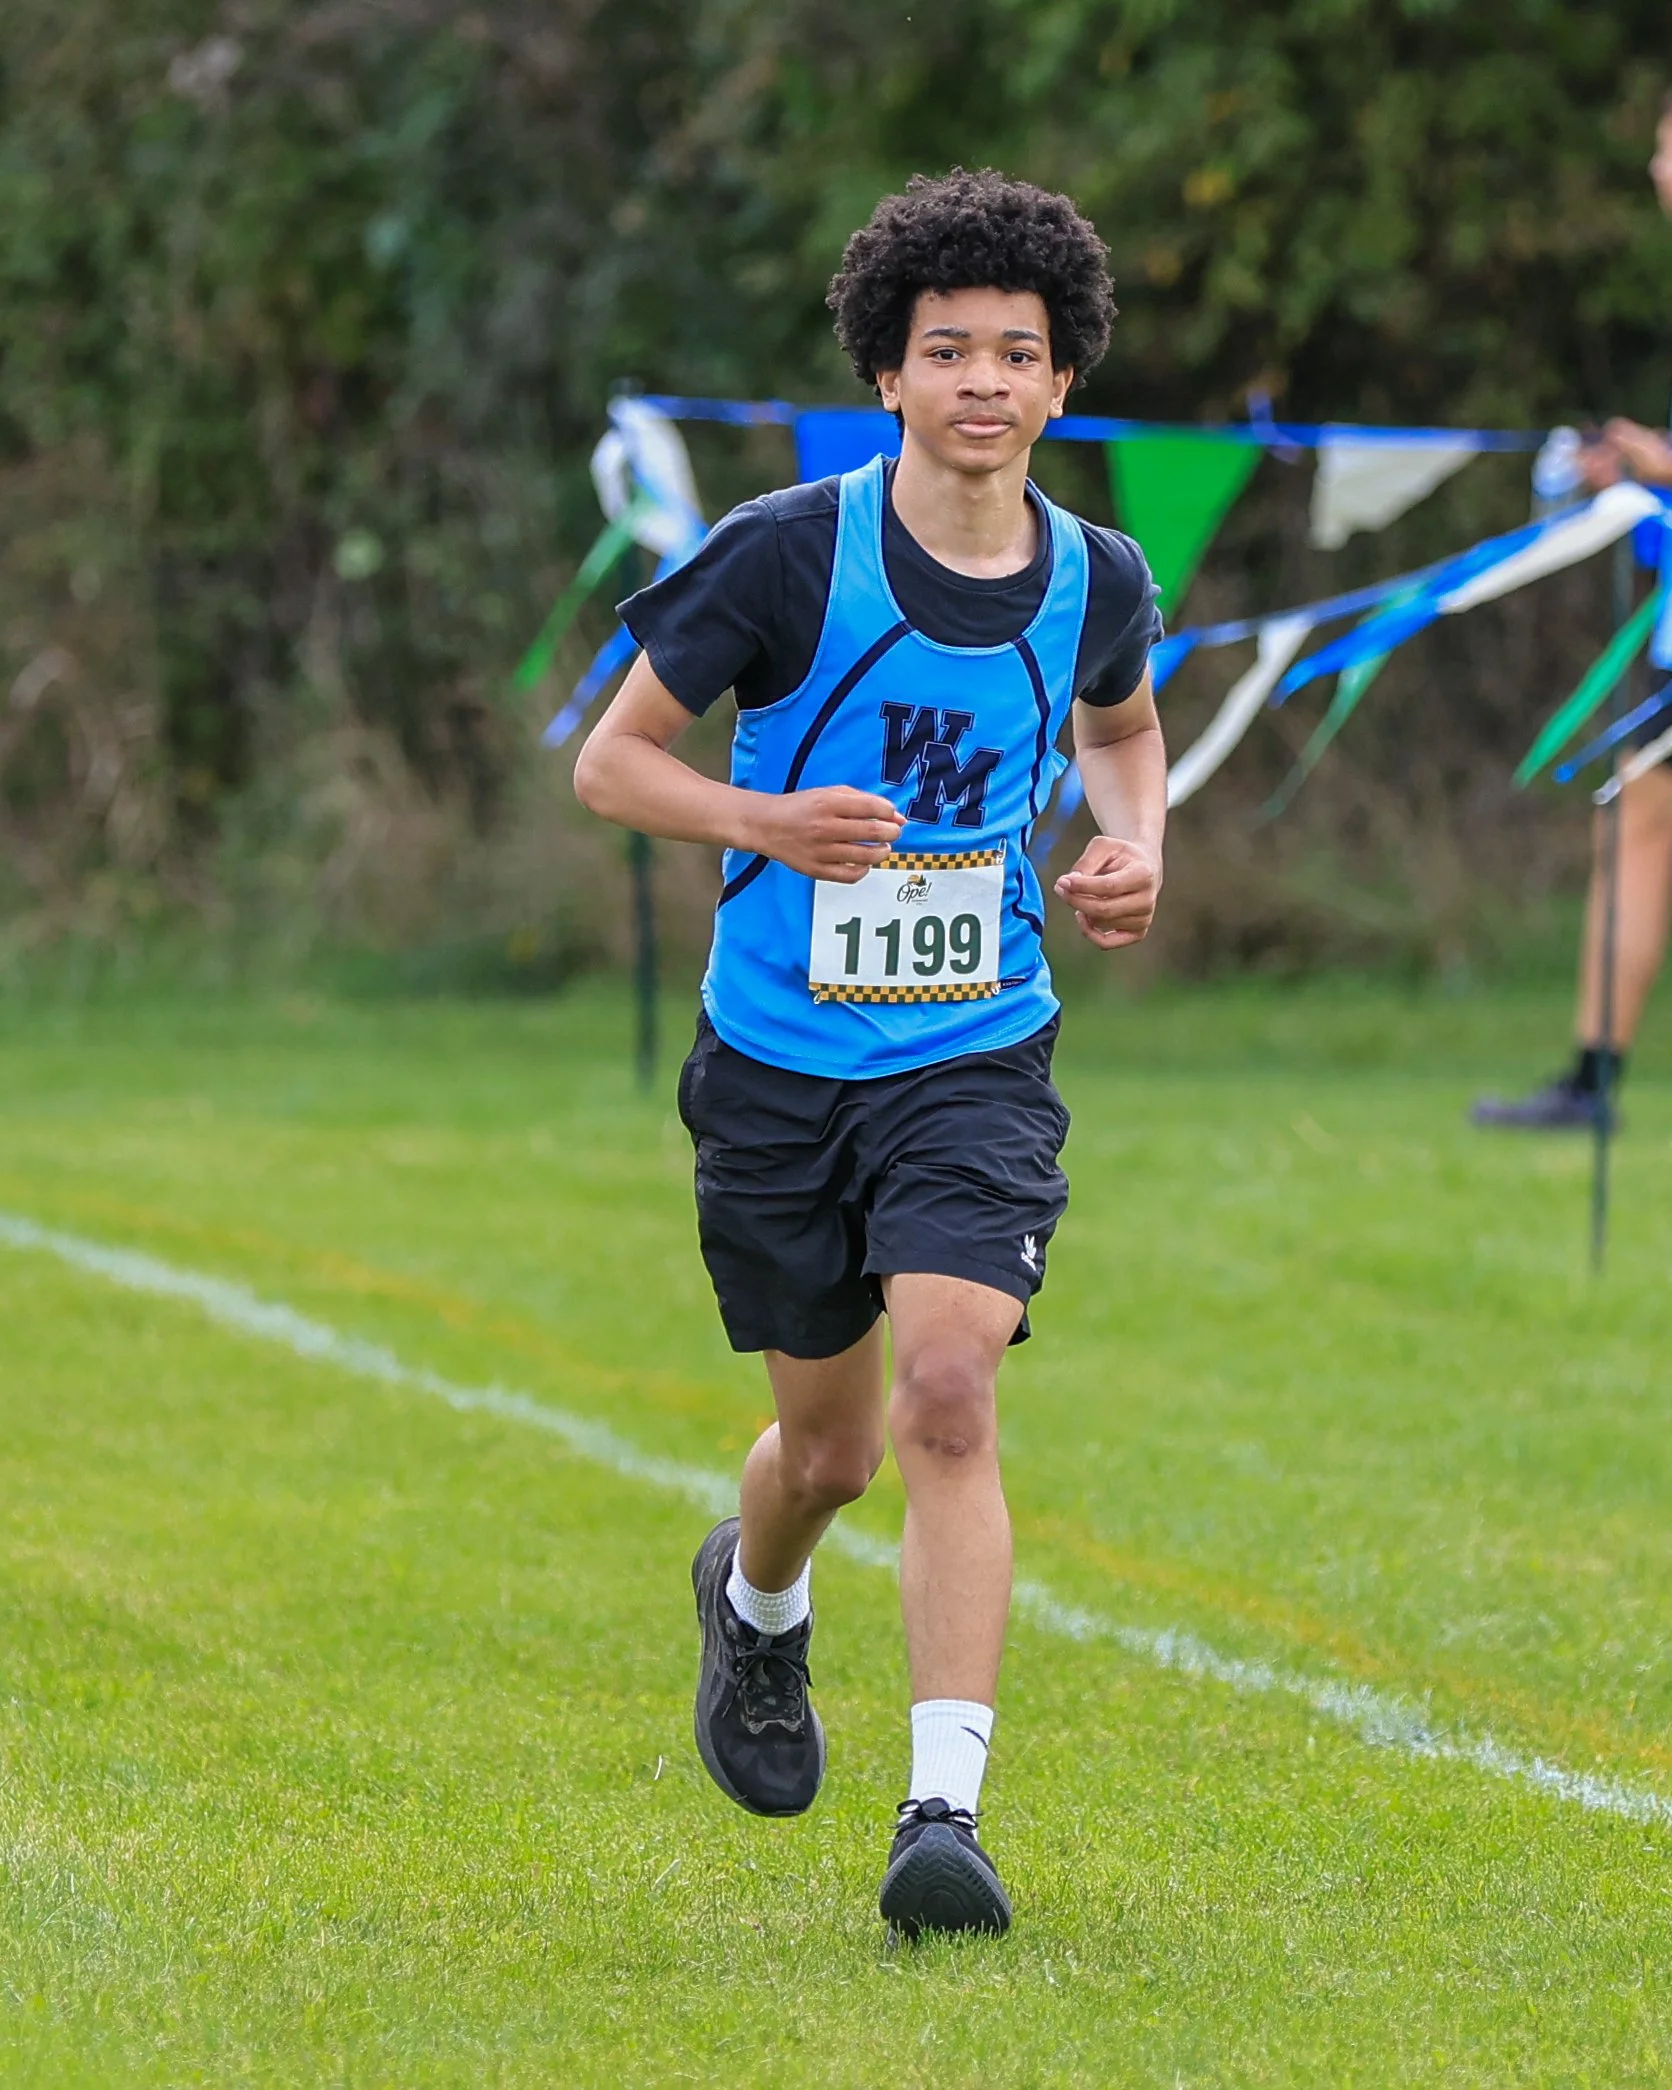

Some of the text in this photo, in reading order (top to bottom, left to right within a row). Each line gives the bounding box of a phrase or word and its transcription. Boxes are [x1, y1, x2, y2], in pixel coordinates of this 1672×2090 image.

[880, 701, 1003, 828] WM
[896, 881, 933, 904] Ope!
[834, 913, 982, 976] 1199
